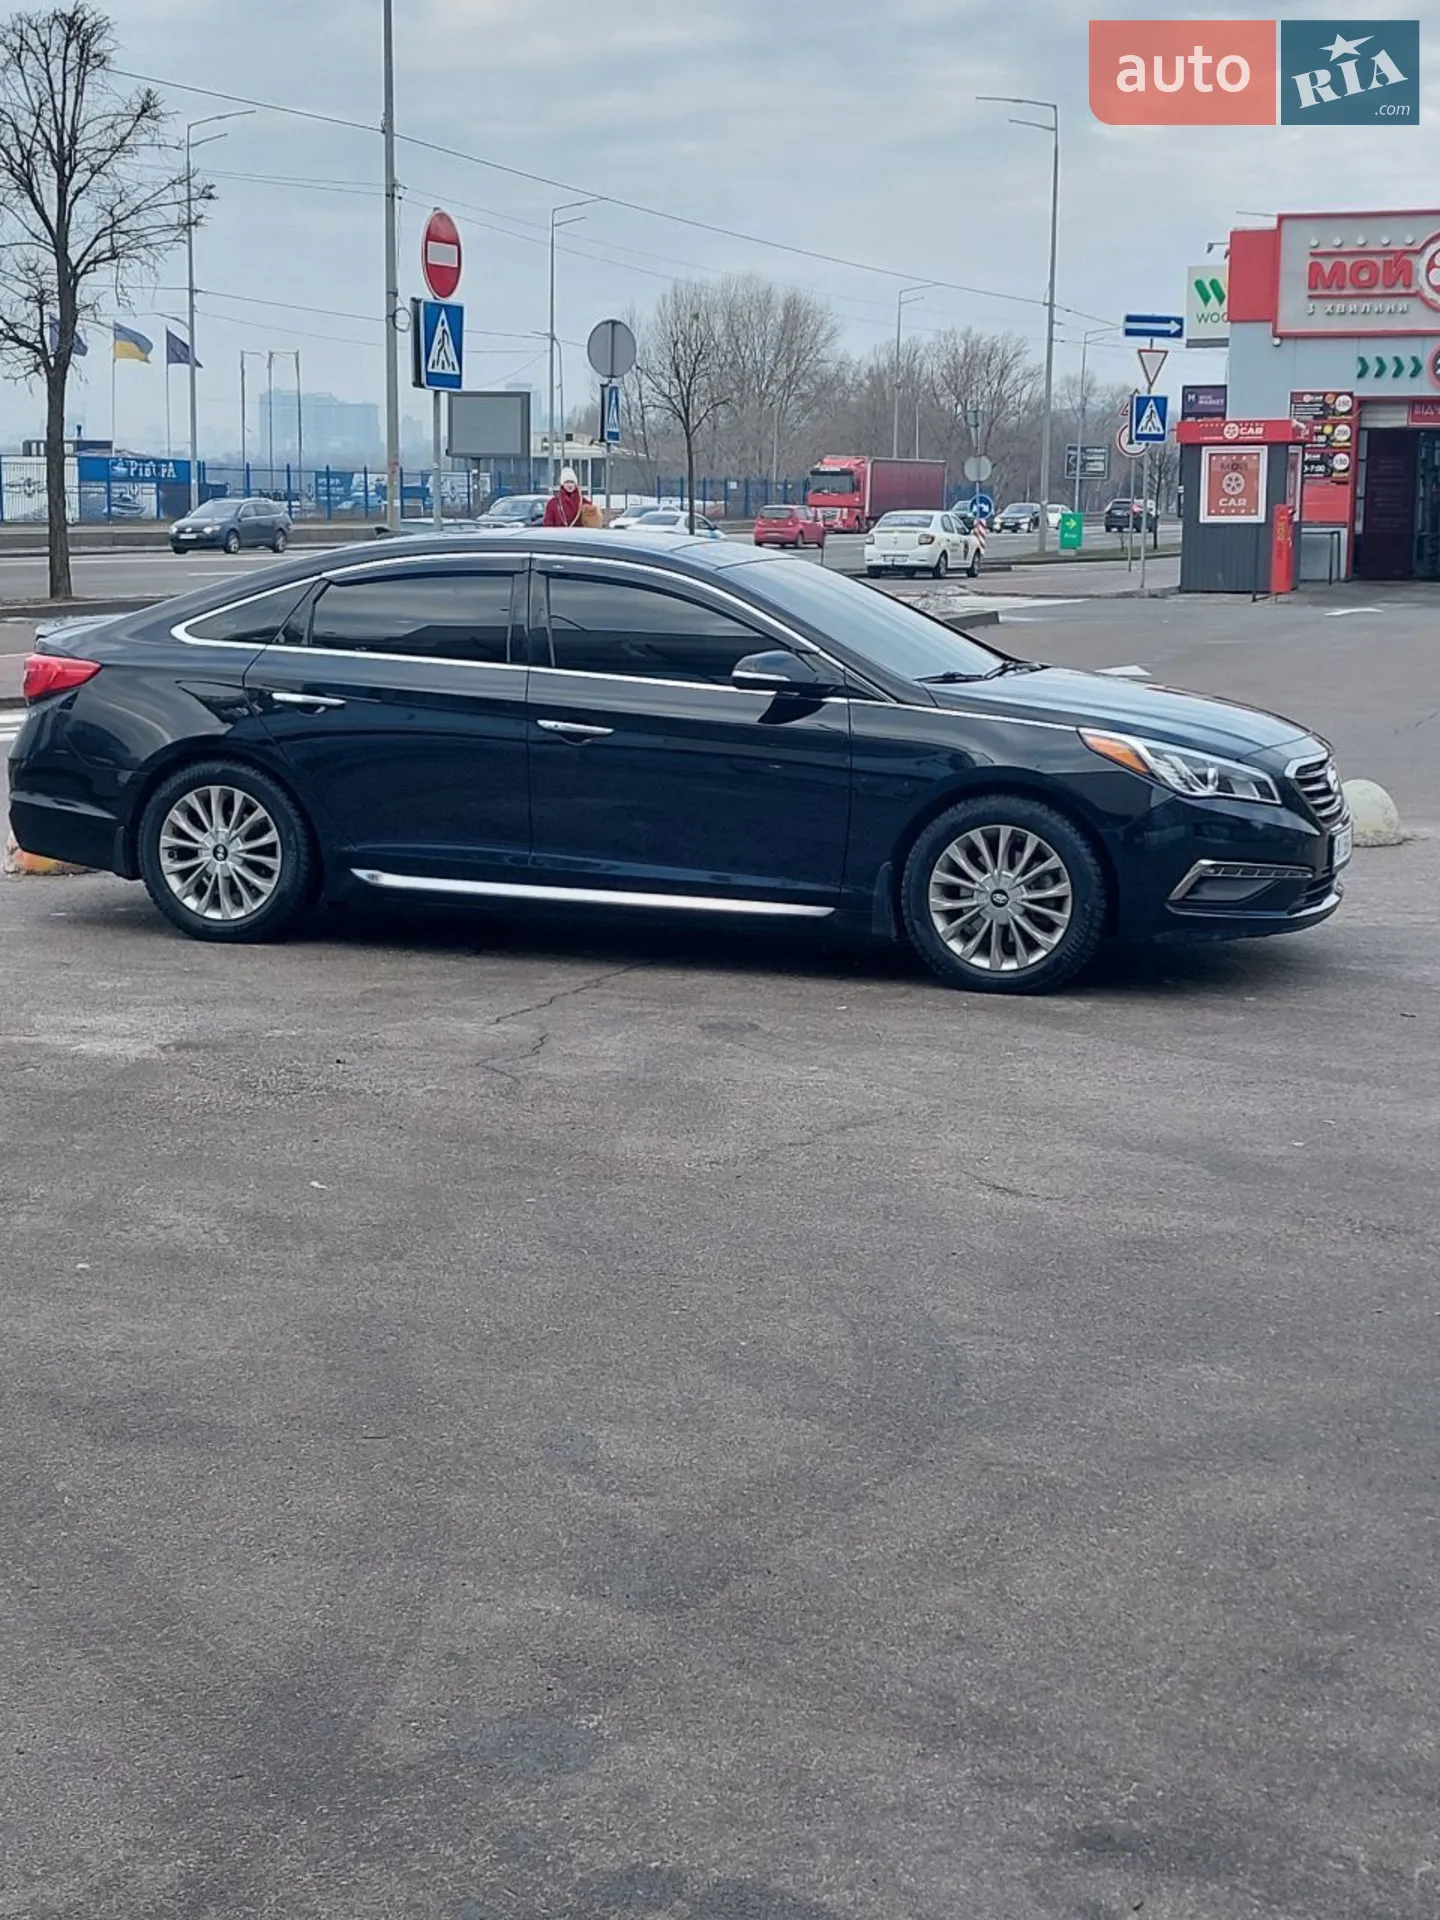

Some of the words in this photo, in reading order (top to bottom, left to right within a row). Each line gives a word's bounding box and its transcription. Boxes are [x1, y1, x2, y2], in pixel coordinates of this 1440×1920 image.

[1307, 252, 1413, 291] МОЙ
[1239, 427, 1264, 436] CAR
[1218, 498, 1248, 507] CAR
